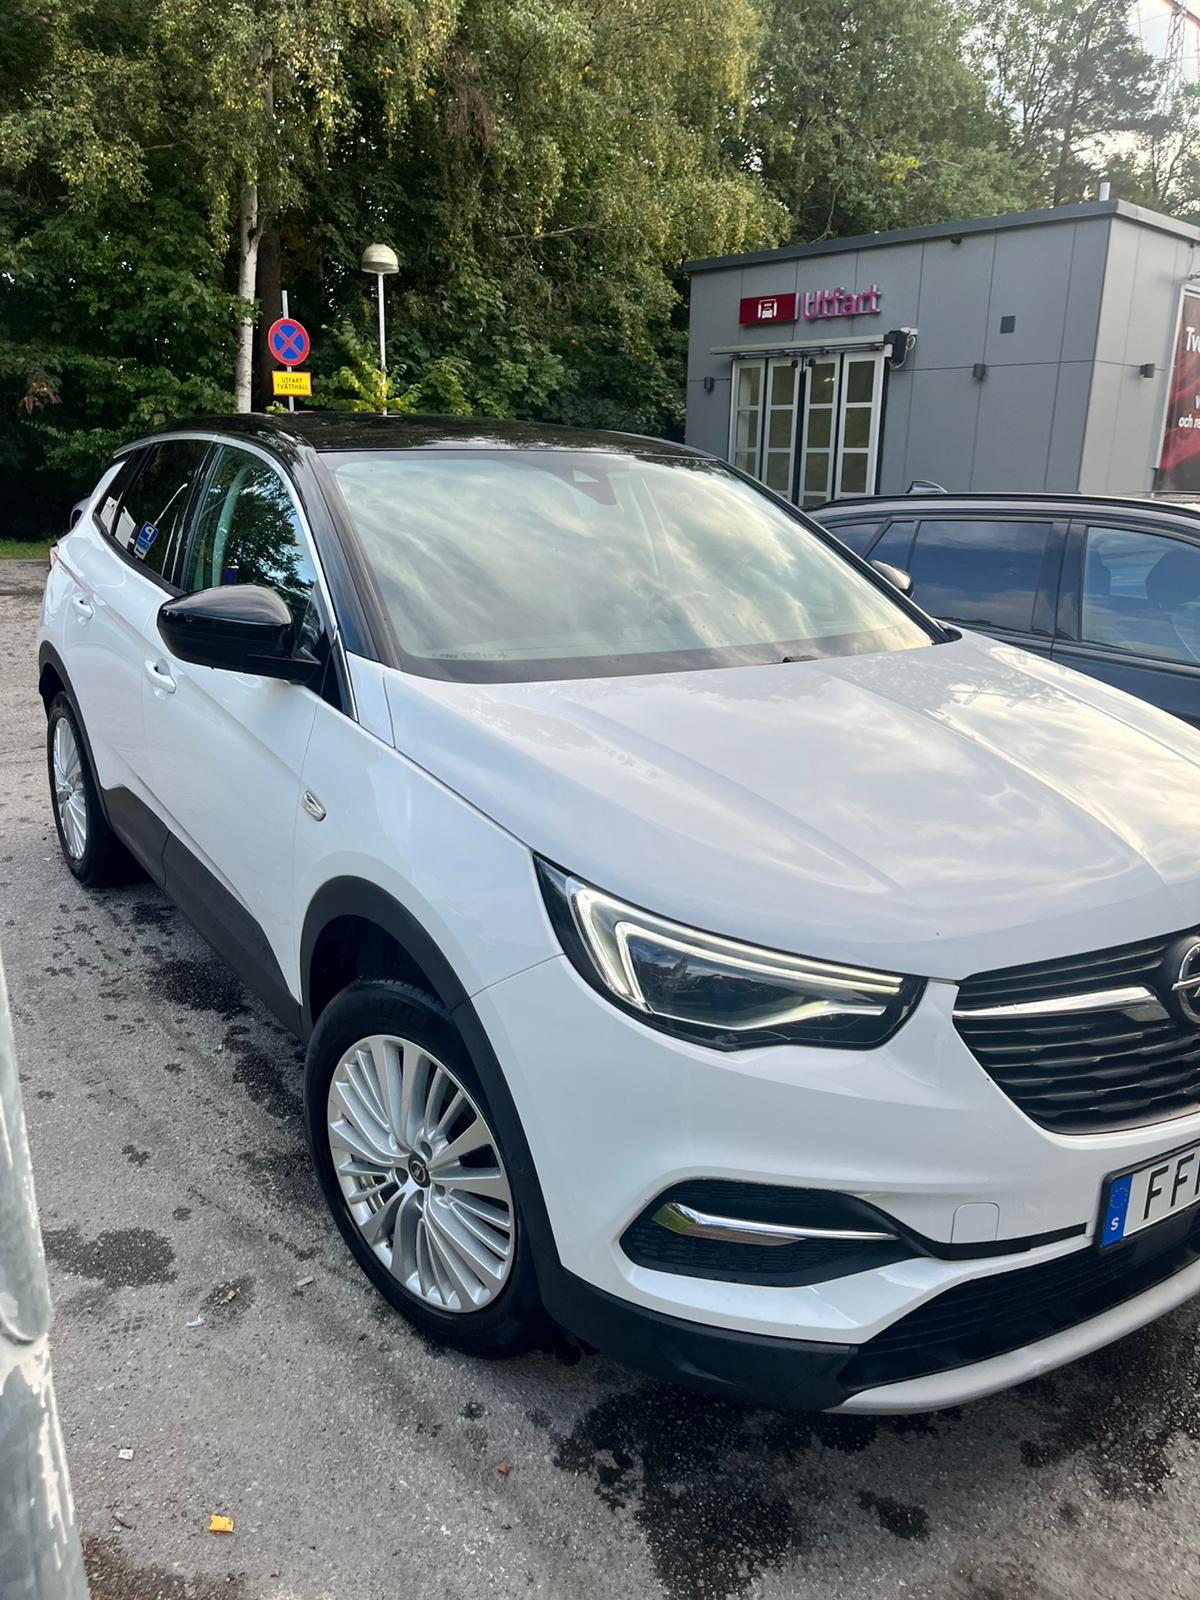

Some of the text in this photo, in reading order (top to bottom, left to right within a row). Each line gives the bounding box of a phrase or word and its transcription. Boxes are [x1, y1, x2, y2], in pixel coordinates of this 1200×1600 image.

[803, 285, 879, 320] Utfart
[1178, 413, 1193, 428] och
[1142, 1152, 1200, 1221] FF
[1110, 1217, 1120, 1231] S
